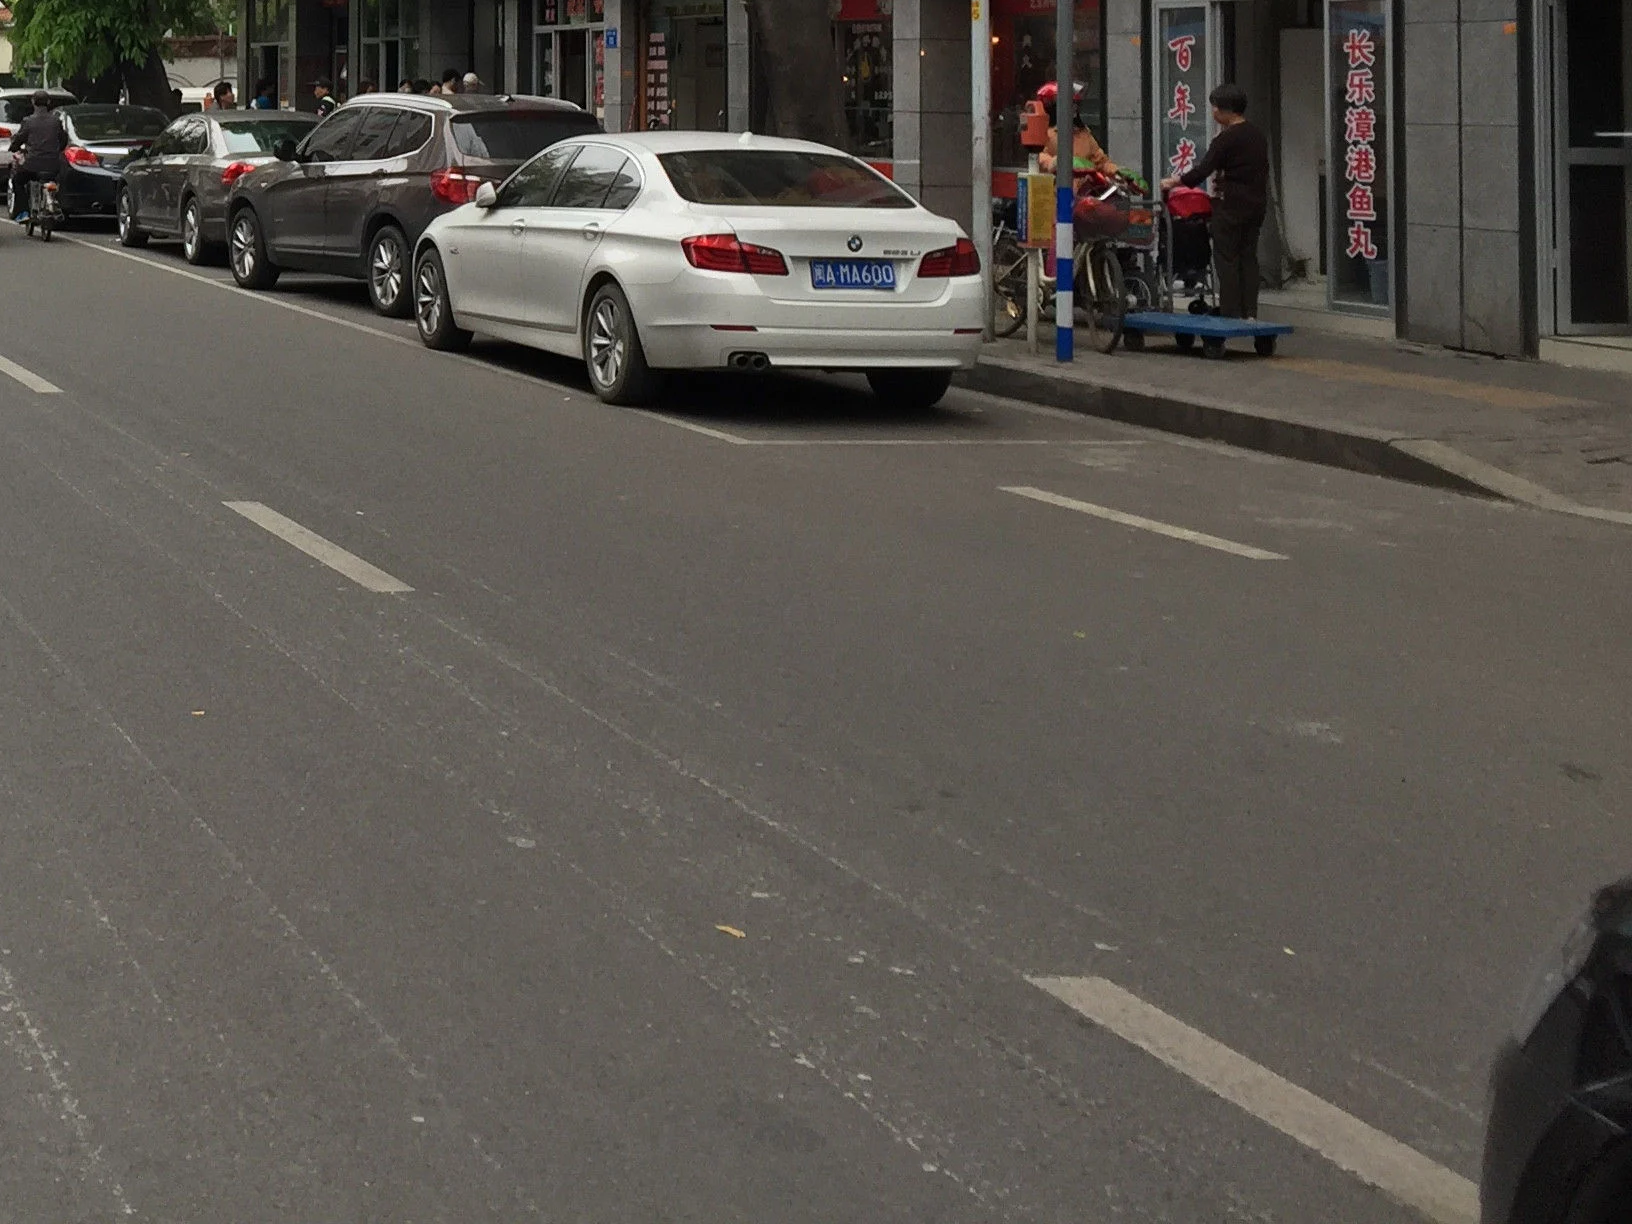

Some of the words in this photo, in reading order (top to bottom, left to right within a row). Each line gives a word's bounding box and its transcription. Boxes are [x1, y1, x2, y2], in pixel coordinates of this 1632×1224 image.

[1343, 29, 1378, 260] 长乐漳港鱼丸
